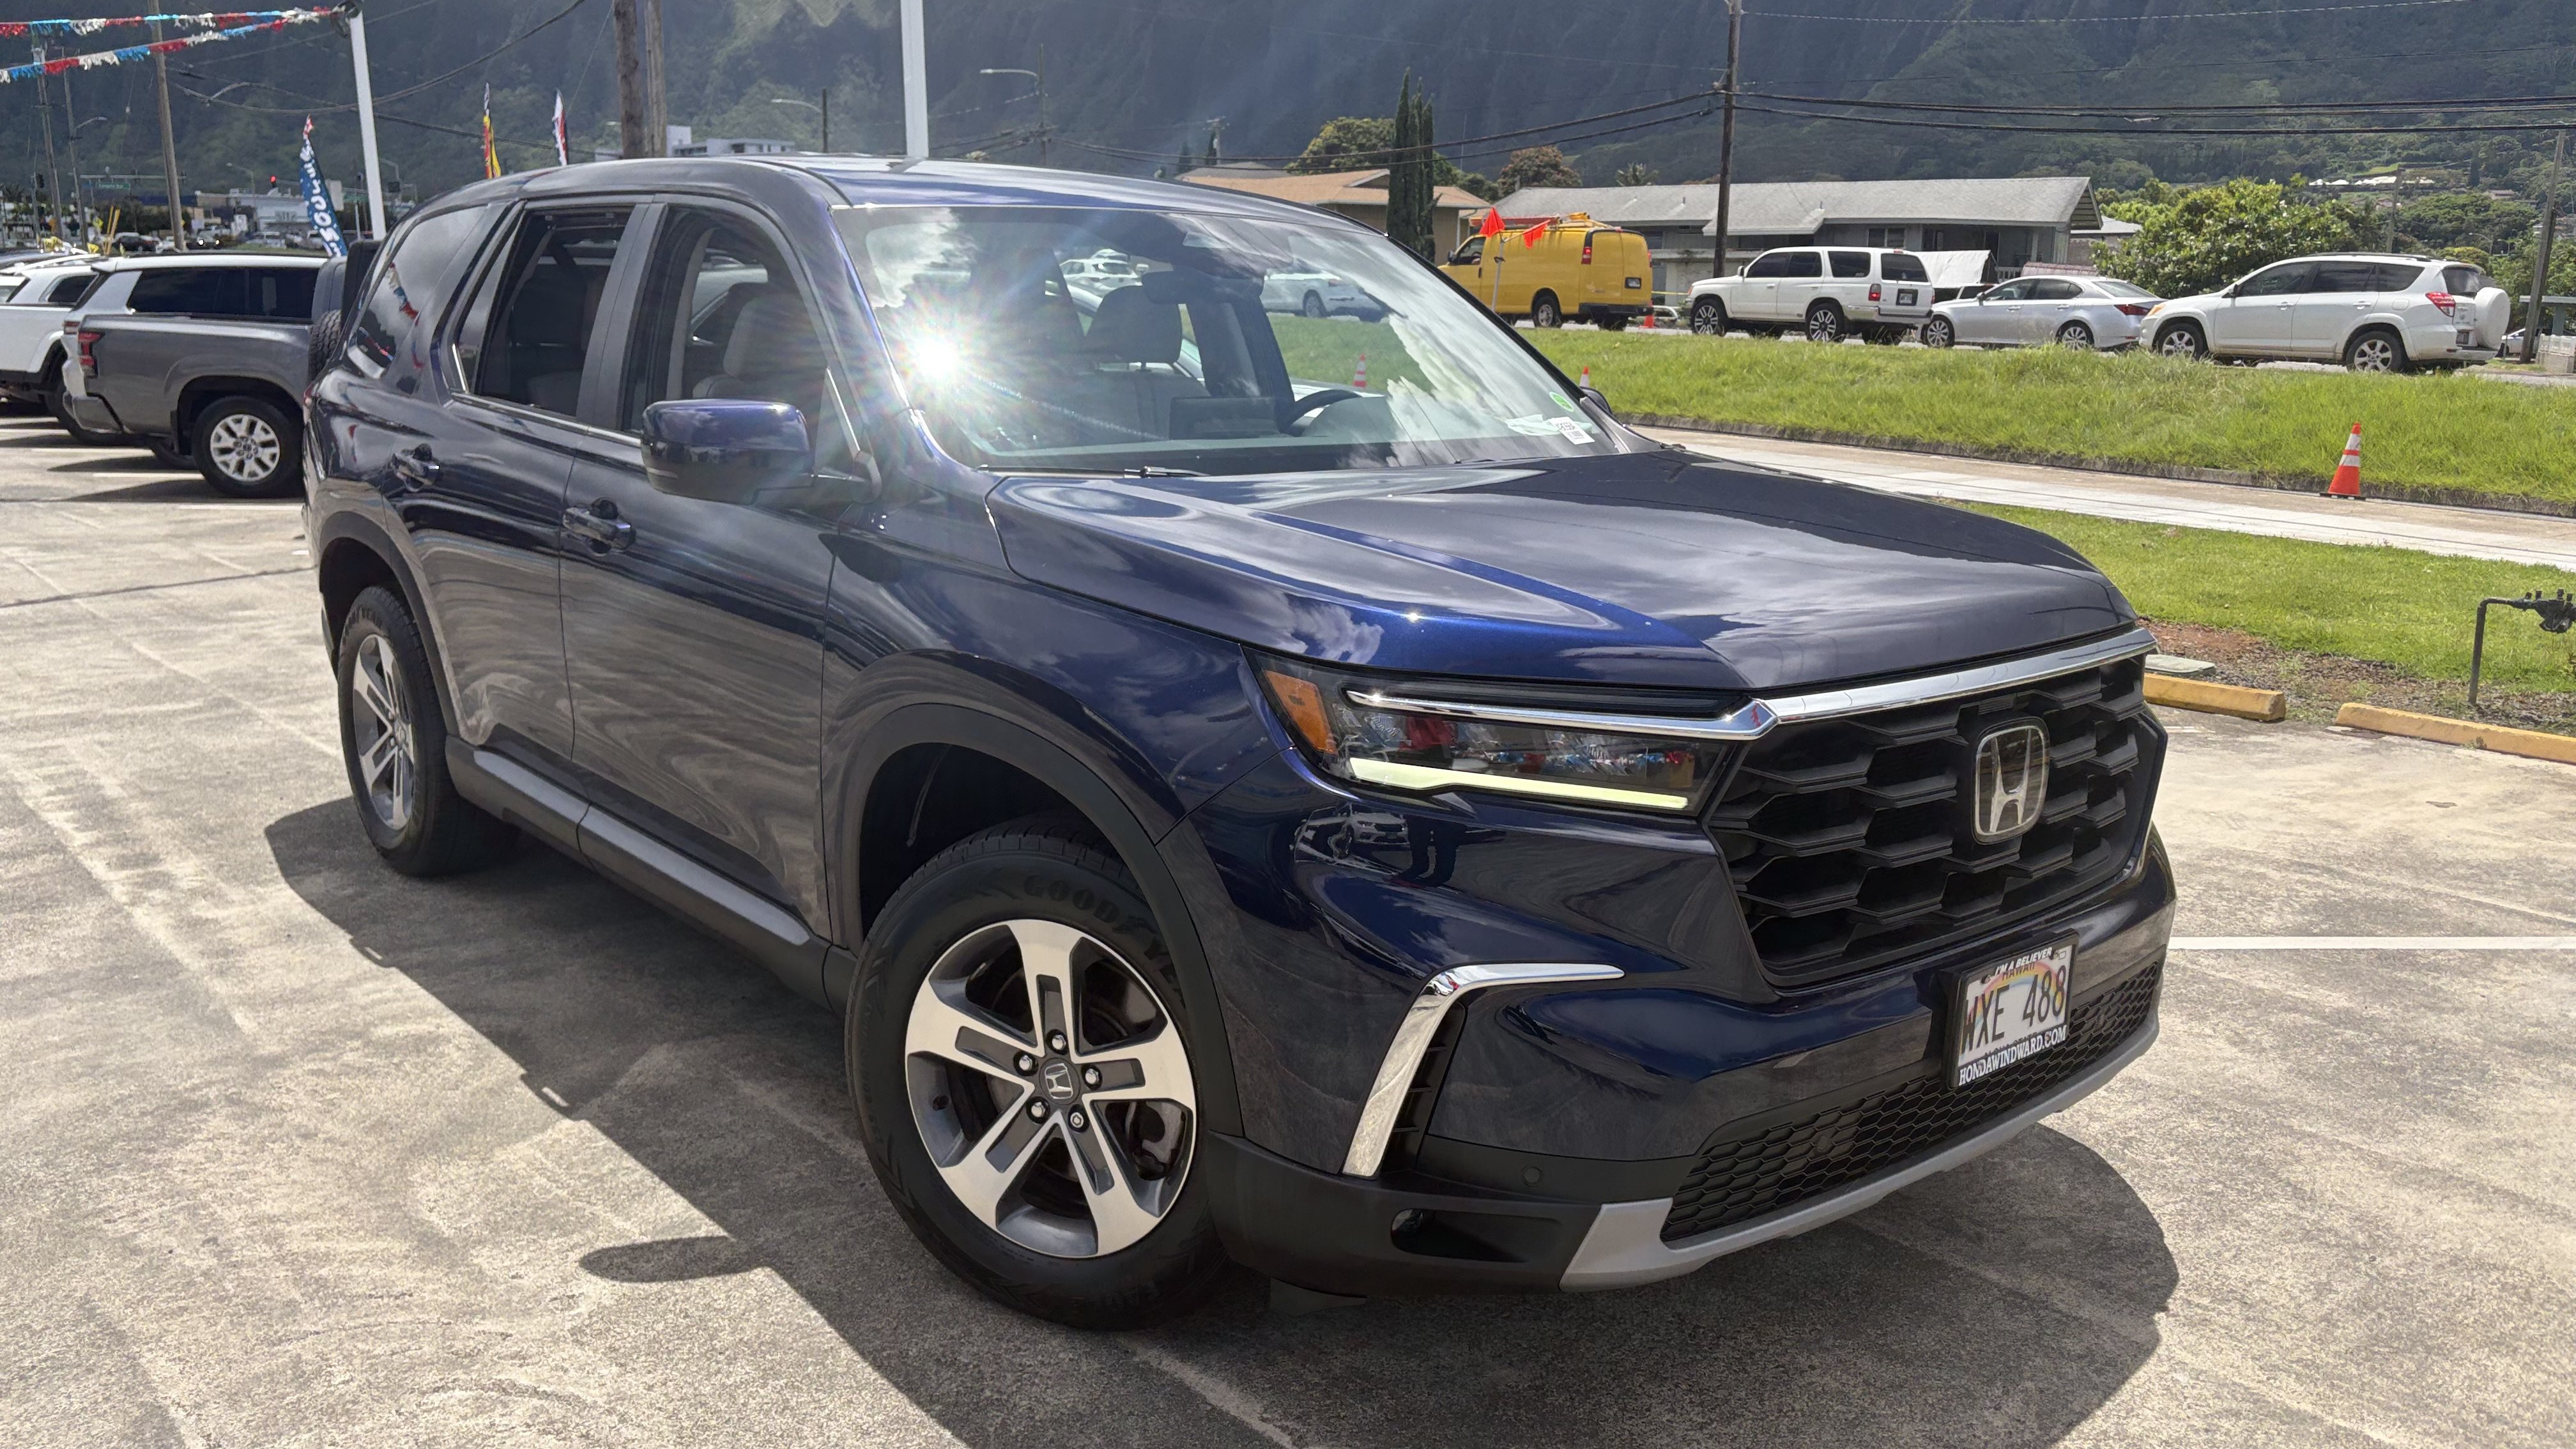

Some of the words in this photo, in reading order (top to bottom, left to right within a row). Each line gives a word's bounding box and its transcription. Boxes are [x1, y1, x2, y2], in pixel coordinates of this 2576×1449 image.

[1994, 962, 2008, 977] I'M
[2007, 960, 2014, 972] A
[2015, 946, 2053, 969] BELIEVER
[1961, 985, 2010, 1054] WXE
[2022, 965, 2067, 1027] 488
[1958, 1024, 2067, 1086] HONDAWINDWARD.COM
